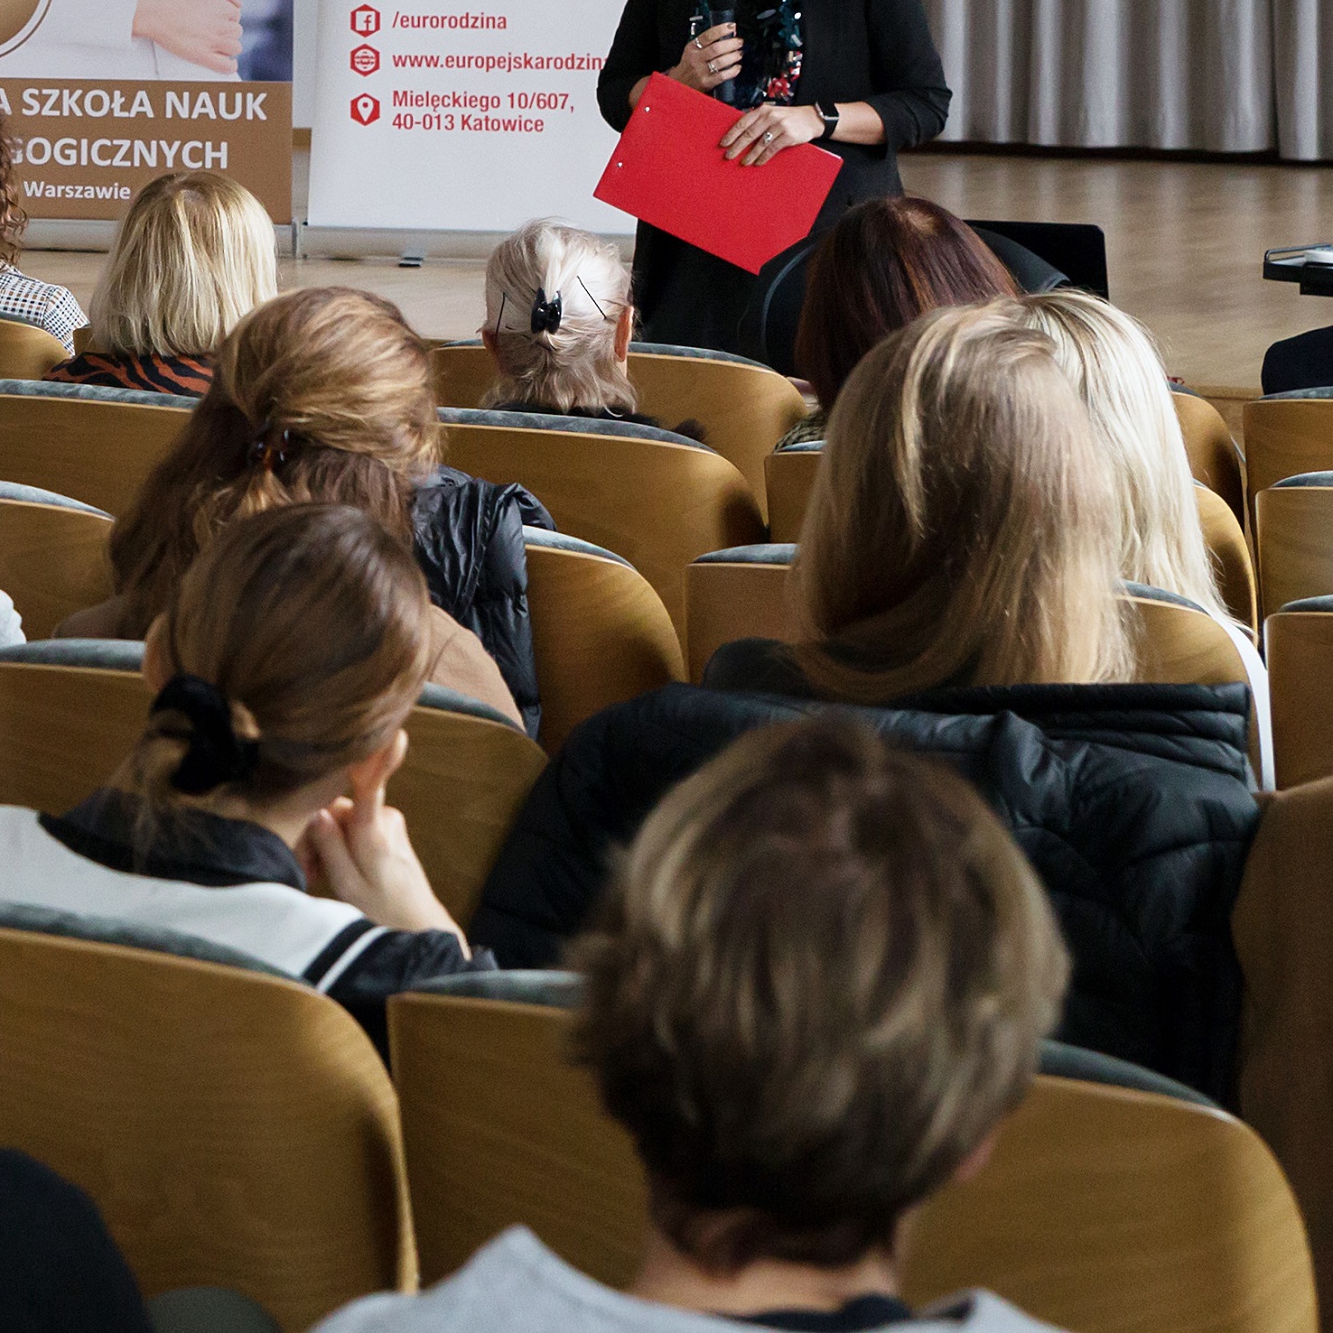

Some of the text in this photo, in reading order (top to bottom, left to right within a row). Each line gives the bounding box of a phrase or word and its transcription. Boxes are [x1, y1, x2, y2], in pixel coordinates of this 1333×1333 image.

[393, 12, 506, 29] /eurorodzina
[393, 53, 607, 72] www.europejskarodzin
[22, 88, 154, 118] SZKOŁA
[166, 91, 266, 120] NAUK
[393, 91, 574, 112] Mielęckiego 10/607,
[393, 113, 544, 132] 40-013 Katowice
[24, 181, 130, 199] Warszawie
